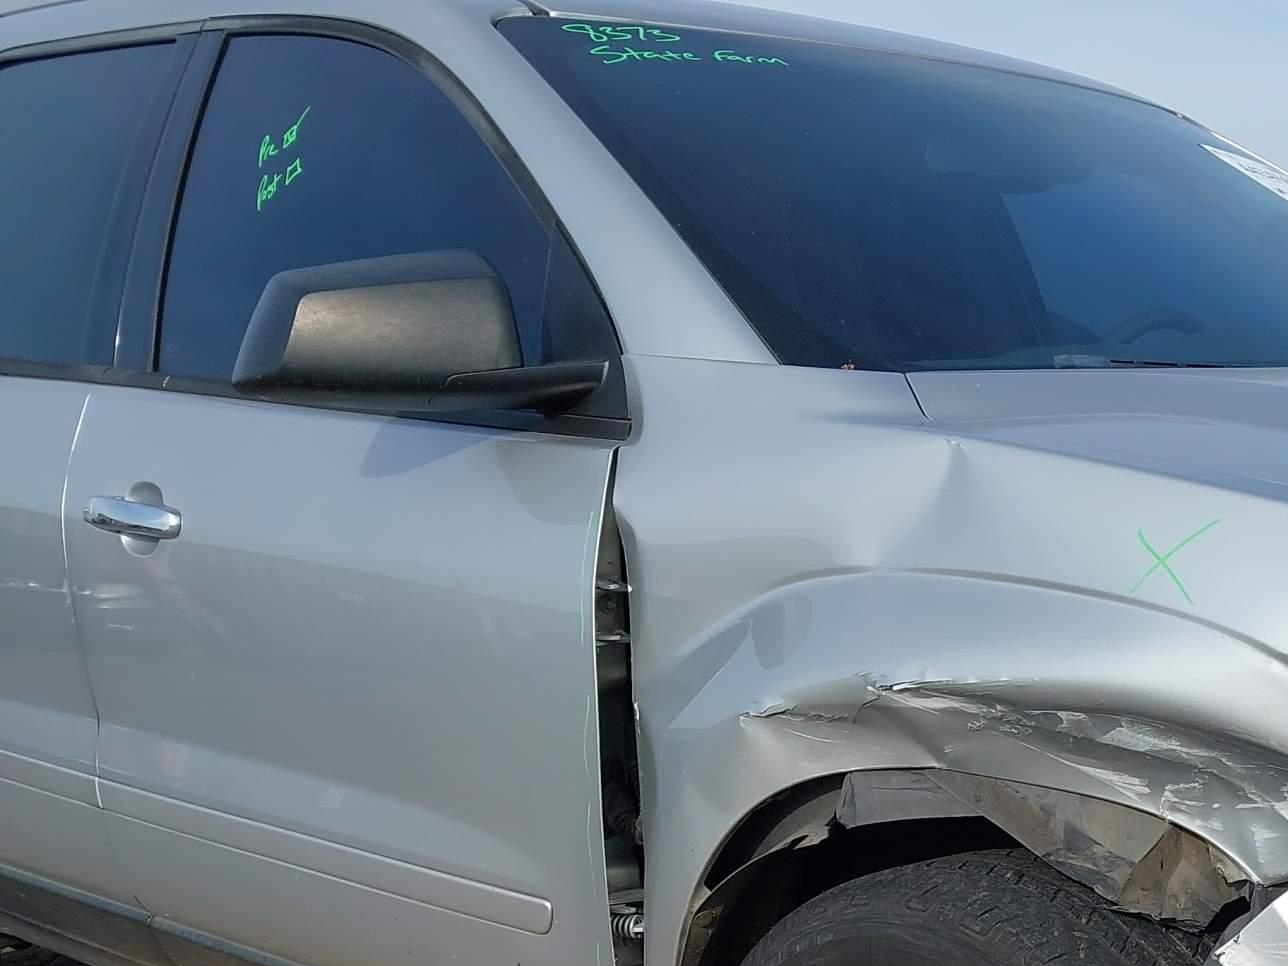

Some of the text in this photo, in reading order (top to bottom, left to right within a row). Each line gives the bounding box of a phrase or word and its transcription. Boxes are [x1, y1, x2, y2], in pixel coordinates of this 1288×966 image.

[561, 23, 681, 42] 8373
[590, 45, 790, 67] State Farm
